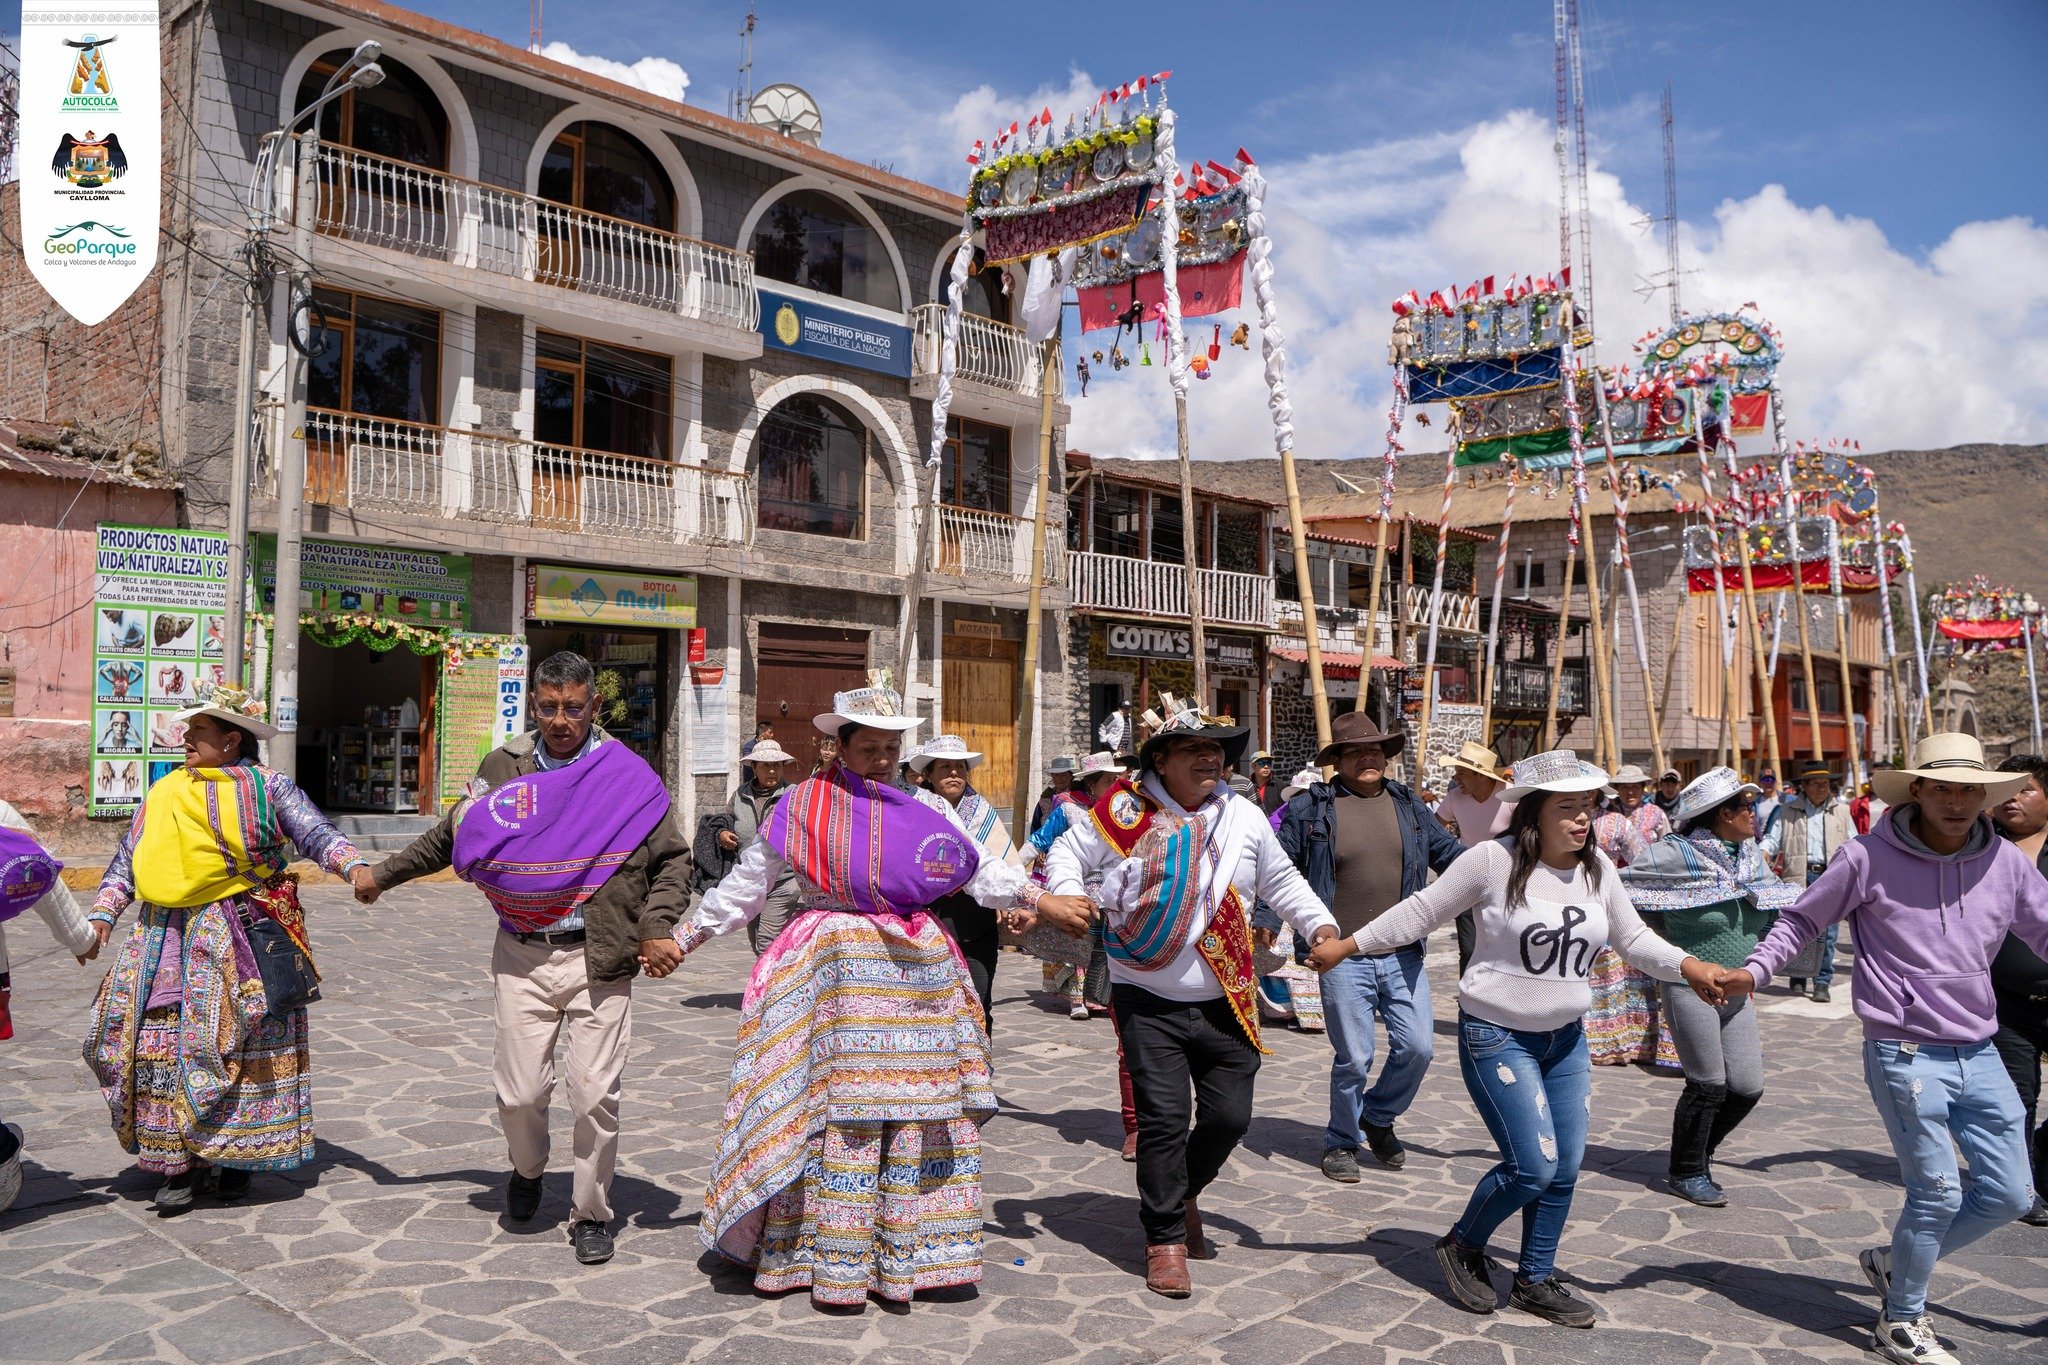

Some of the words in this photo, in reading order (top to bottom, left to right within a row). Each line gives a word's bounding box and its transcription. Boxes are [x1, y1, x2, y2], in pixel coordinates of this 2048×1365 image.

[805, 320, 853, 339] MINISTERIO
[855, 331, 890, 348] PÚBLICO
[804, 329, 838, 346] FISCALÍA
[840, 338, 850, 348] DE
[852, 340, 861, 350] LA
[863, 344, 891, 358] NACIÓN
[100, 529, 176, 552] PRODUCTOS
[98, 551, 125, 570] VIDA
[129, 554, 202, 576] NATURALEZA
[206, 560, 213, 576] Y
[321, 554, 396, 571] NATURALEZA
[401, 561, 408, 572] Y
[410, 563, 447, 576] SALUD
[374, 551, 440, 565] NATURALES
[340, 566, 370, 576] MEDICINA
[112, 576, 138, 584] OFRECE
[174, 581, 204, 589] MEDICINA
[324, 573, 375, 584] ENFERMEDADES
[390, 579, 420, 588] PRESENTA
[643, 582, 677, 593] BOTICA
[262, 577, 326, 590] PRCTOS
[330, 583, 392, 595] NACIONALES
[404, 590, 465, 603] IMPORTADOS
[527, 568, 536, 618] BOTICA
[138, 595, 188, 604] ENFERMEDADES
[632, 614, 664, 623] Soluciones
[1111, 626, 1190, 654] COTTA'S
[1220, 646, 1252, 658] DRINKS
[94, 809, 129, 817] SEPARE
